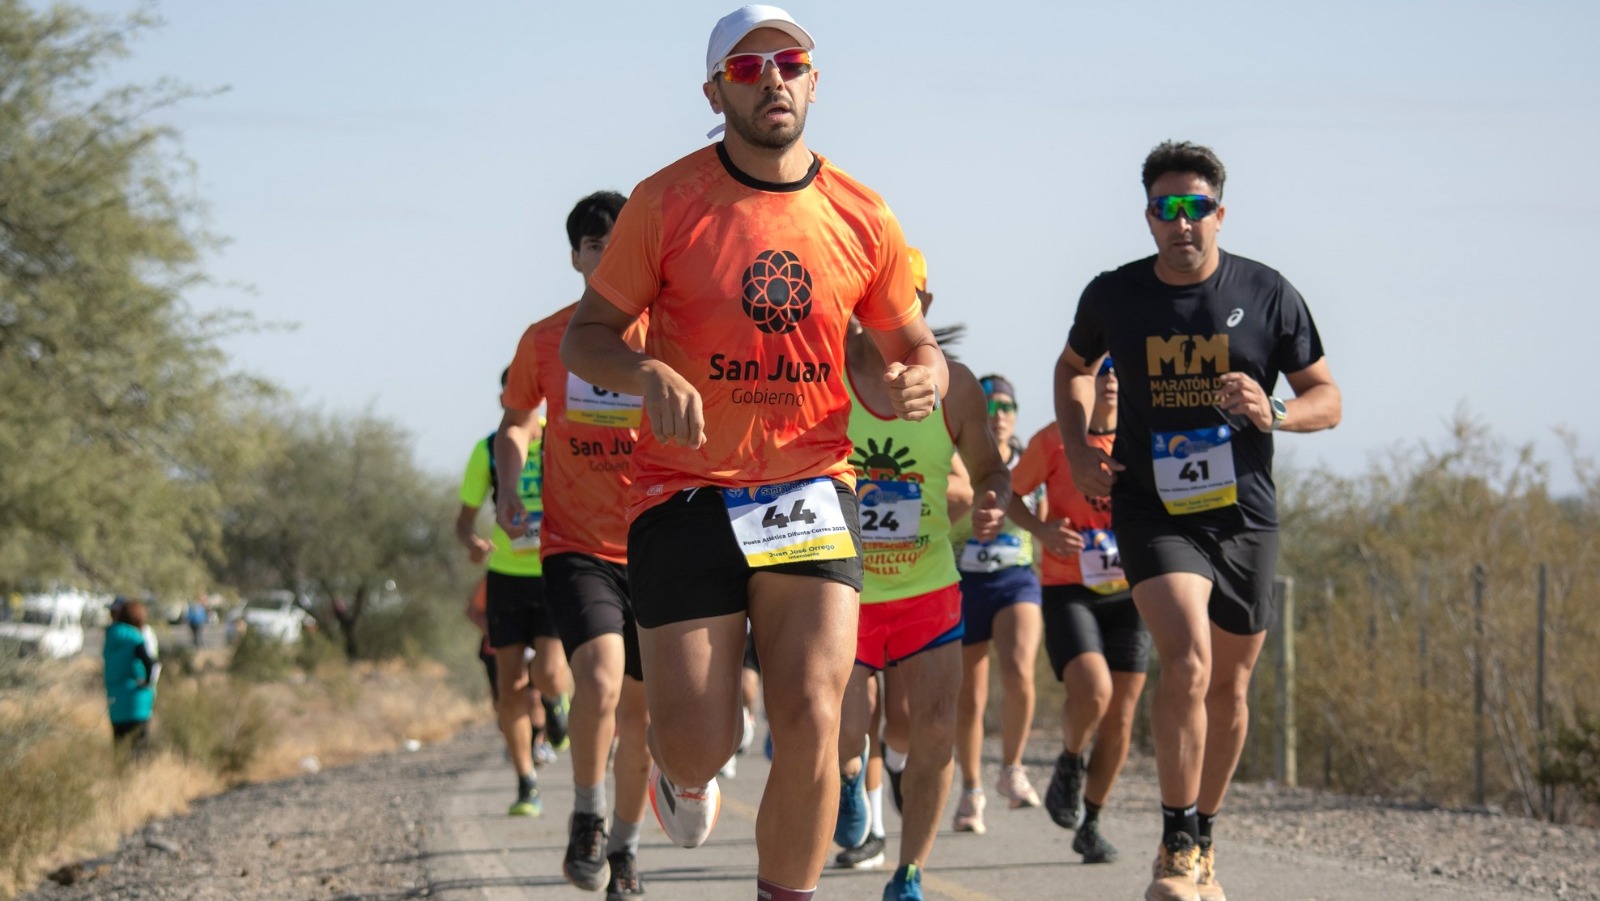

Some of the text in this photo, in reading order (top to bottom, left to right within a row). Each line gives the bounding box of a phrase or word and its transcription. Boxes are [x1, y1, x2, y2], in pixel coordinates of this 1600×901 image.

[708, 353, 831, 383] San Juan
[1150, 376, 1222, 391] MARATÓN D
[731, 387, 805, 407] Gobierno
[570, 437, 637, 456] San Ju
[1178, 460, 1209, 482] 41
[761, 498, 817, 529] 44
[861, 509, 899, 531] 24
[762, 533, 786, 543] Atlética
[787, 529, 811, 538] Difunta
[789, 547, 807, 555] José
[808, 544, 835, 552] Orrego
